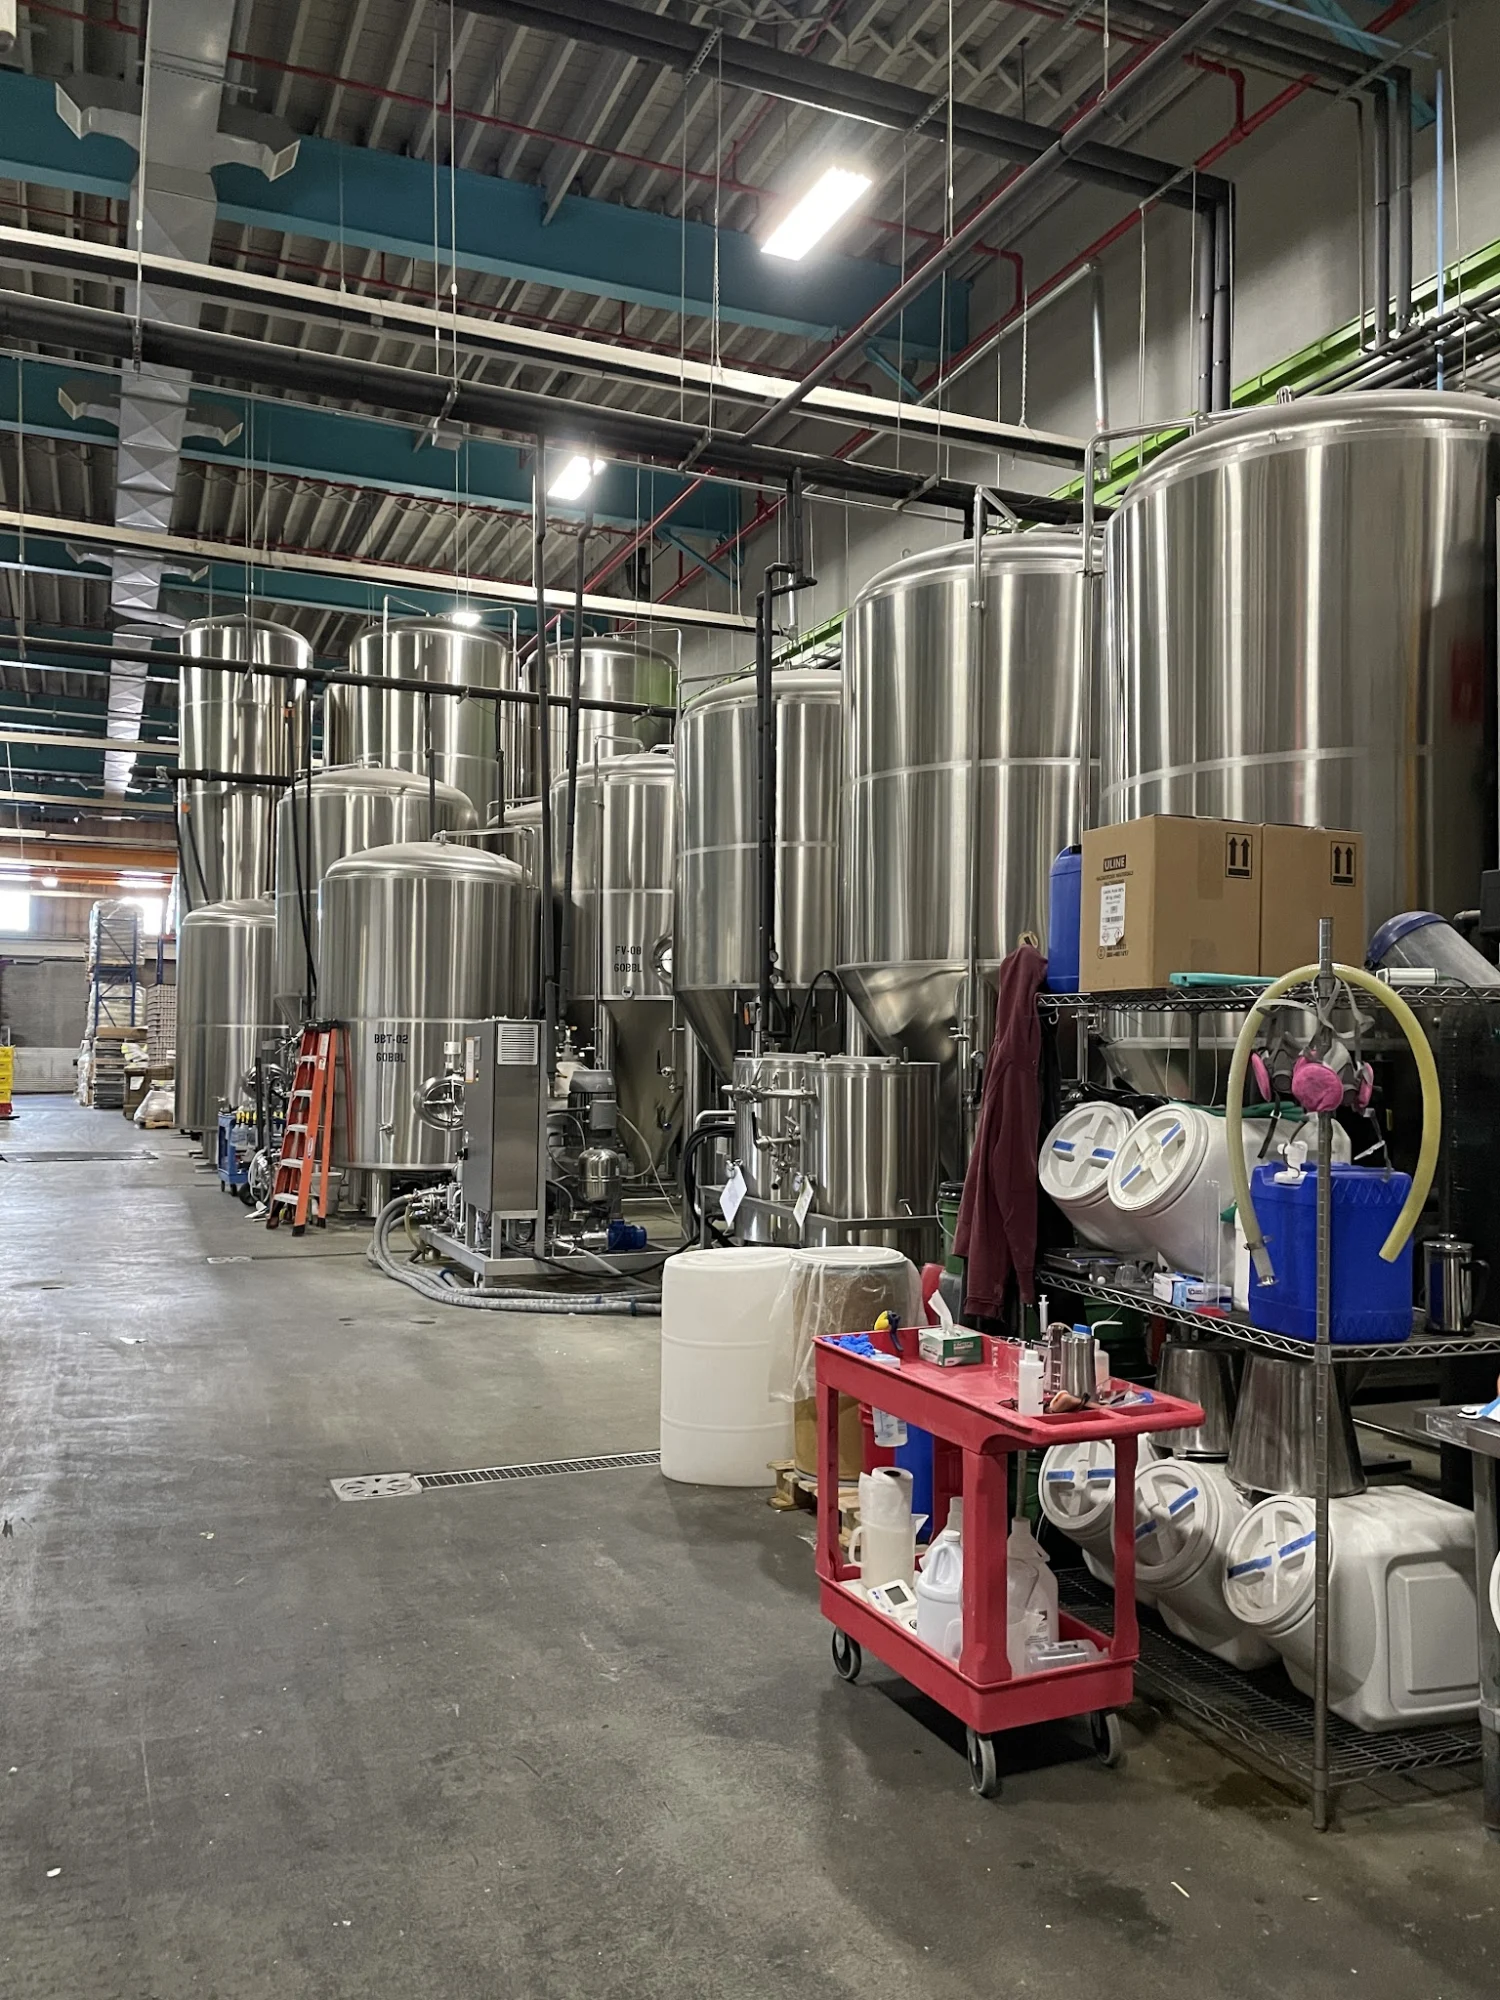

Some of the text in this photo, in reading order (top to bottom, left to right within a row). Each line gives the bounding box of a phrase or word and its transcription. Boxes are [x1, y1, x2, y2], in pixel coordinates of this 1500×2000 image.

[1104, 857, 1125, 870] ULINE
[614, 963, 643, 973] 60BBL
[374, 1034, 409, 1044] BBT-02
[376, 1052, 406, 1063] 60BBL
